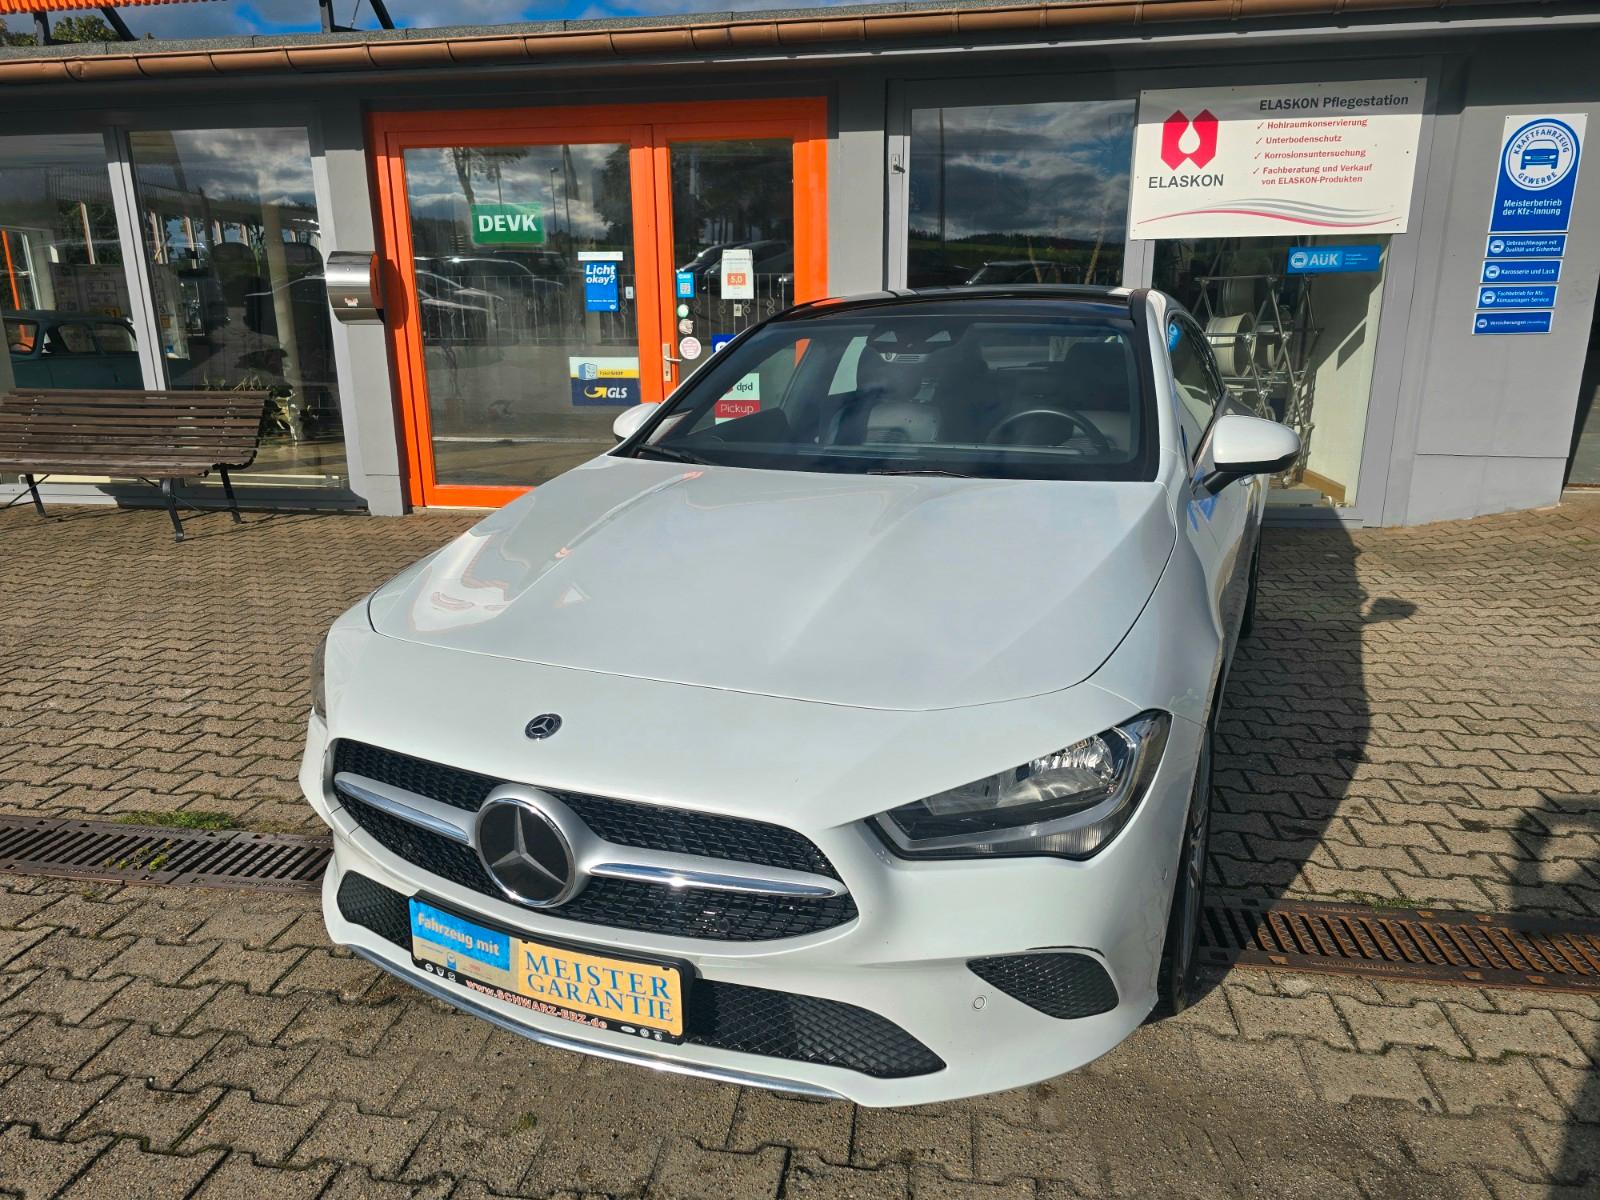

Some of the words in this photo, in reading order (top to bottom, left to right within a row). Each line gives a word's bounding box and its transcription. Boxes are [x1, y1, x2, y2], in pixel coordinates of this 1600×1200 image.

[1259, 97, 1319, 111] ELASKON
[1322, 94, 1409, 110] Pflegestation
[1267, 118, 1368, 130] Hohlraumkonservierung
[1265, 135, 1342, 145] Unterbodenschutz
[1513, 129, 1570, 155] KRAFTFAHRZEUG
[1264, 149, 1366, 160] Korrosionsuntersuchung
[1262, 165, 1321, 175] Fachberatung
[1322, 164, 1338, 172] und
[1340, 163, 1373, 172] Verkauf
[1148, 173, 1224, 189] ELASKON
[1278, 175, 1363, 185] ELASKON-Produkten
[1518, 171, 1558, 185] GEWERBE
[1503, 199, 1563, 208] Meisterbetrieb
[1502, 207, 1516, 216] der
[1517, 207, 1561, 217] Kfz-Innung
[478, 214, 537, 232] DEVK
[1309, 253, 1338, 266] AÜK
[585, 264, 616, 275] Licht
[585, 274, 616, 286] okay?
[607, 387, 628, 399] GLS
[736, 382, 753, 393] dpd
[720, 403, 754, 416] Pickup
[417, 912, 473, 949] Fahrzeug
[476, 939, 500, 957] mit
[524, 949, 671, 1000] MEISTER
[527, 973, 674, 1022] GARANTIE
